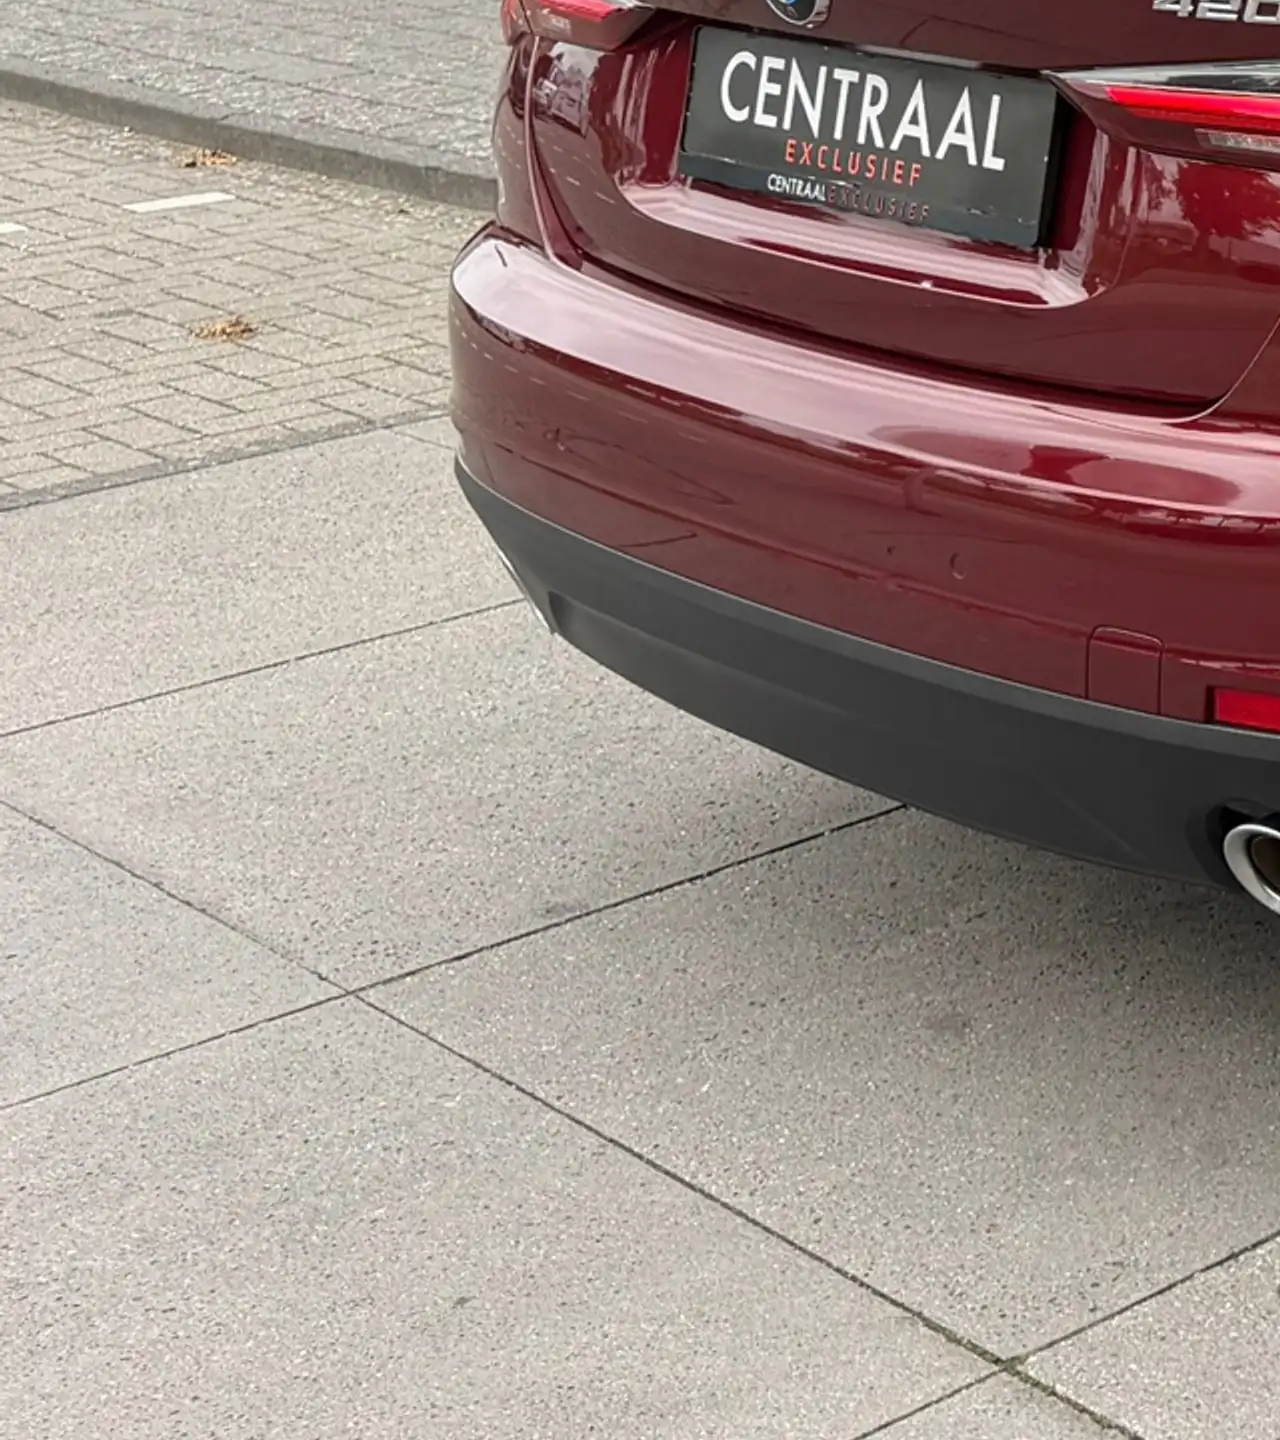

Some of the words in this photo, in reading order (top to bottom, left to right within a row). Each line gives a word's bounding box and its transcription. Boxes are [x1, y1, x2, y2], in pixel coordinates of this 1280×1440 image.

[720, 50, 1005, 171] CENTRAAL
[785, 139, 921, 187] EXCLUSIEF
[768, 174, 826, 202] CENTRAAL
[827, 185, 930, 221] EXCLUSIEF
